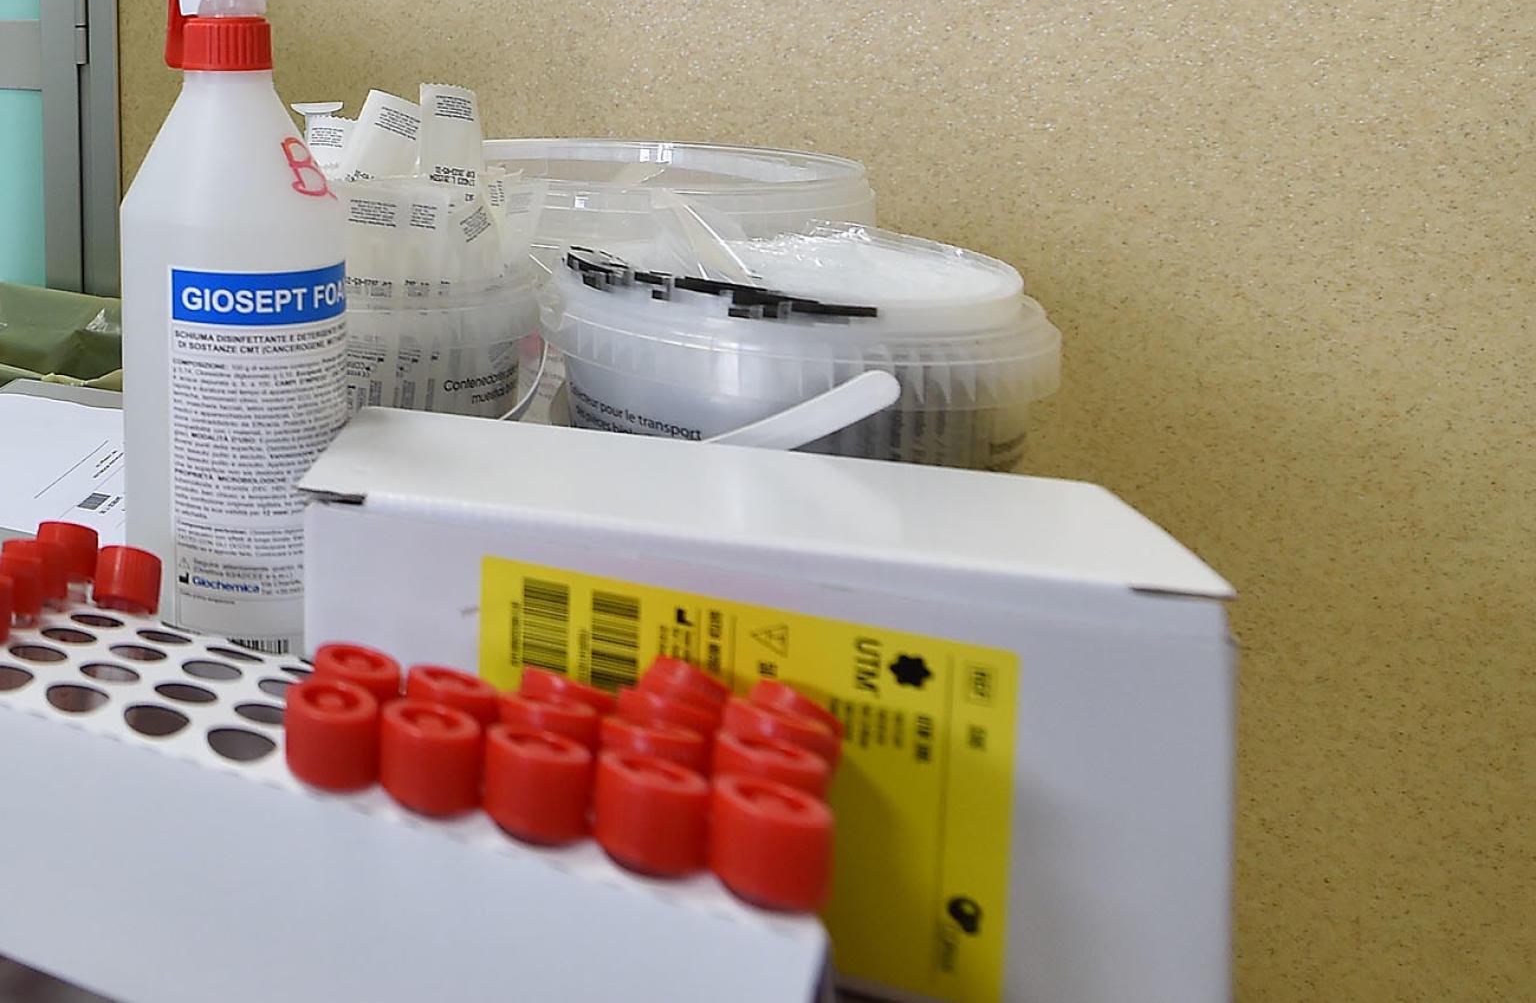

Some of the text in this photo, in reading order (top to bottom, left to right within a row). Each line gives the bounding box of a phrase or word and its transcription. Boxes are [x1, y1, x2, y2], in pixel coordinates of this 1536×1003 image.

[181, 286, 308, 314] GIOSEPT
[637, 415, 702, 441] transport
[192, 575, 260, 594] Giochemica
[855, 636, 881, 693] UTM
